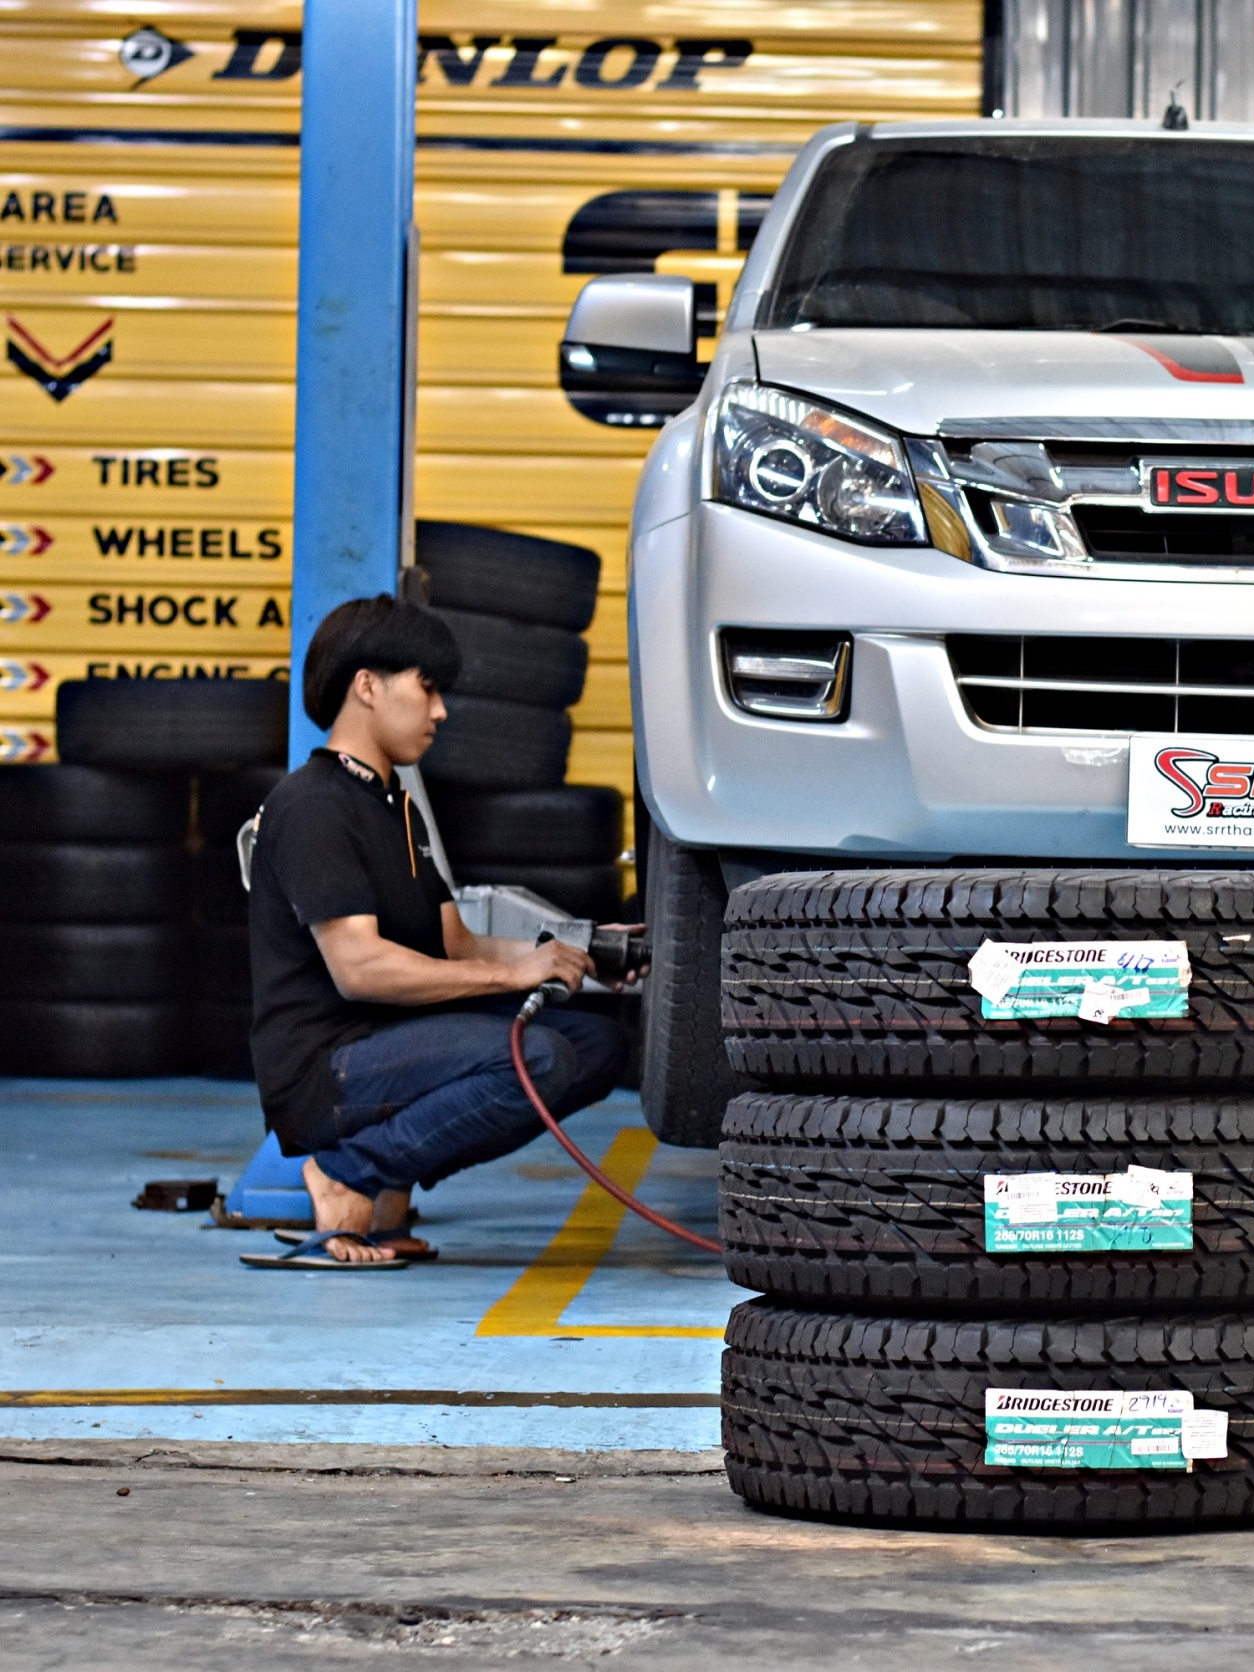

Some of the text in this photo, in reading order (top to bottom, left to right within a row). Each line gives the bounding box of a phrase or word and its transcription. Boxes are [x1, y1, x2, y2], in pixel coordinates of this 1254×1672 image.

[211, 28, 753, 91] DNLOP
[0, 190, 118, 223] AREA
[0, 244, 137, 274] ERVICE
[93, 456, 220, 488] TIRES
[92, 526, 283, 561] WHEELS
[88, 594, 238, 627] SHOCK
[1056, 1229, 1085, 1241] 112S
[996, 1394, 1114, 1412] BRIDGESTONE
[994, 1423, 1100, 1435] DUELER
